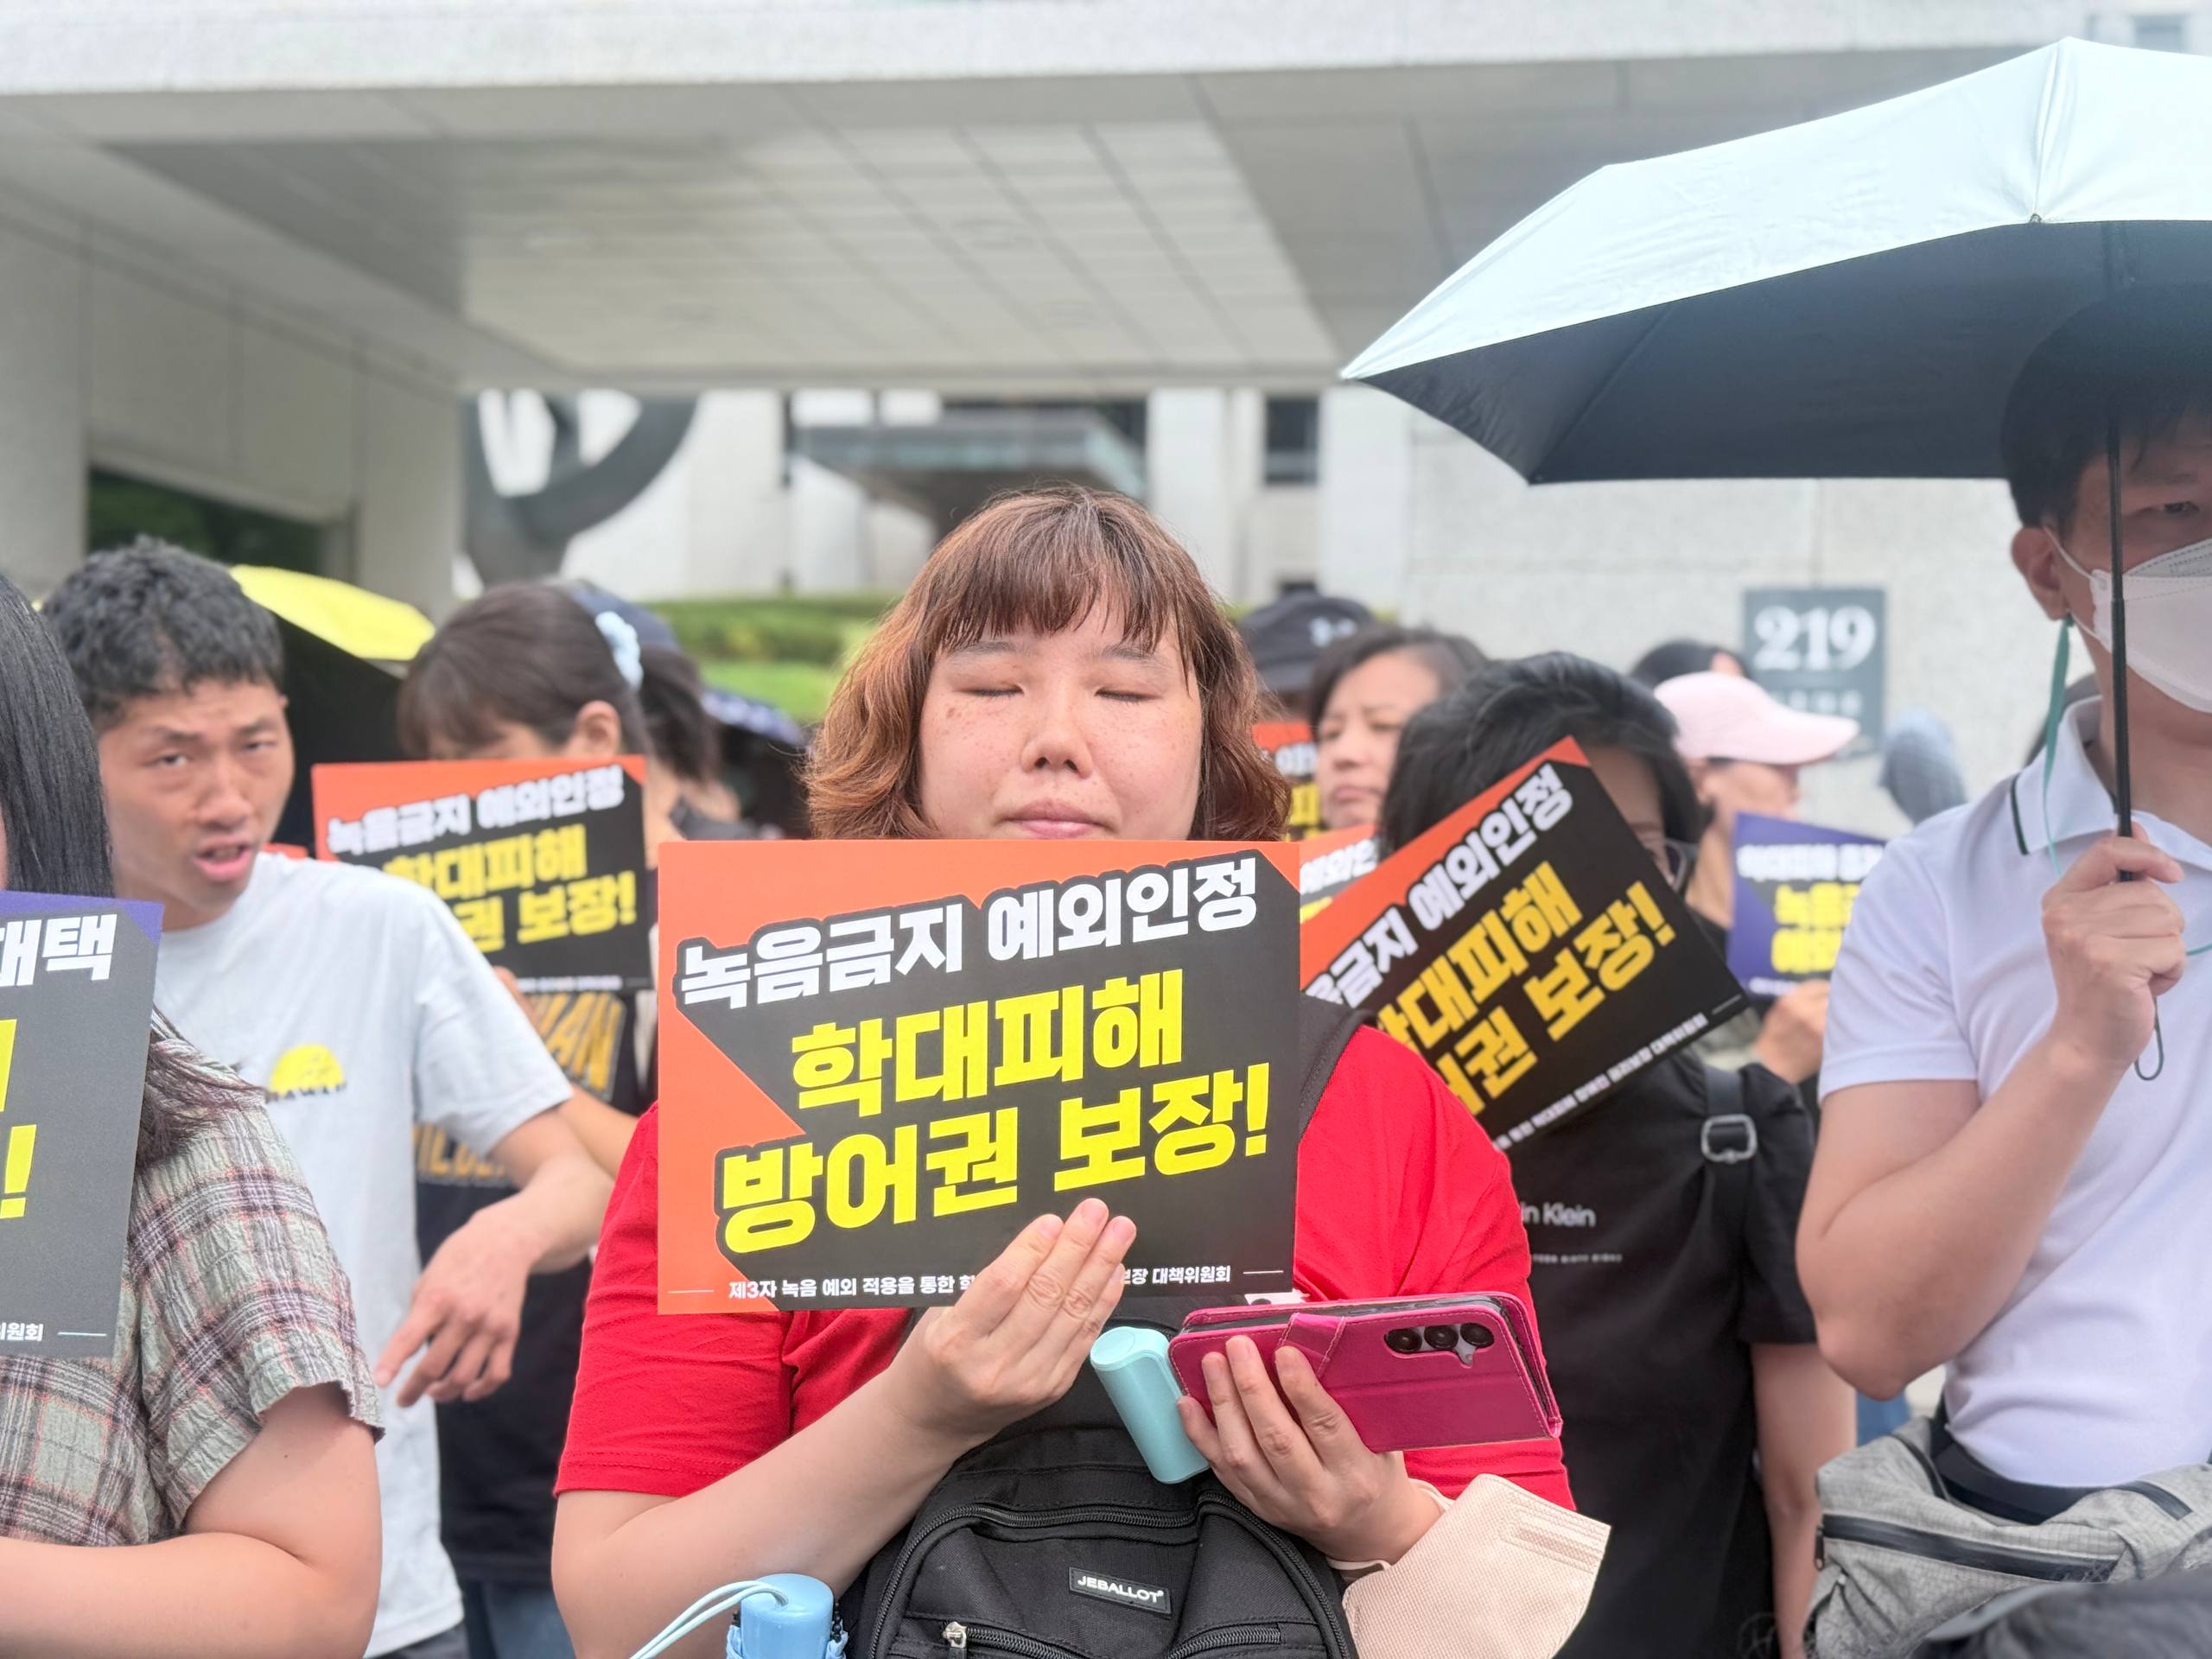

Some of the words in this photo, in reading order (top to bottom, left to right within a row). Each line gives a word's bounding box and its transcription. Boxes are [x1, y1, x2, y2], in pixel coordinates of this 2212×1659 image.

[1753, 606, 1876, 671] 219
[1408, 762, 1573, 931] 예외인정
[517, 870, 638, 944] 보장!
[681, 903, 963, 1009] 녹음금지
[987, 856, 1258, 960] 예외인정
[1522, 880, 1676, 1041] 보장!
[791, 968, 1184, 1117] 학대피해
[722, 1107, 1019, 1254] 방어권
[1053, 1063, 1271, 1192] 보장!
[1542, 1202, 1597, 1227] Klein
[728, 1280, 777, 1299] 제3자
[782, 1278, 817, 1298] 녹음
[822, 1278, 857, 1296] 예외
[862, 1276, 915, 1295] 적용을
[919, 1274, 955, 1294] 통한
[1152, 1265, 1231, 1285] 대책위원회
[1077, 1576, 1162, 1603] JEBALLOT
